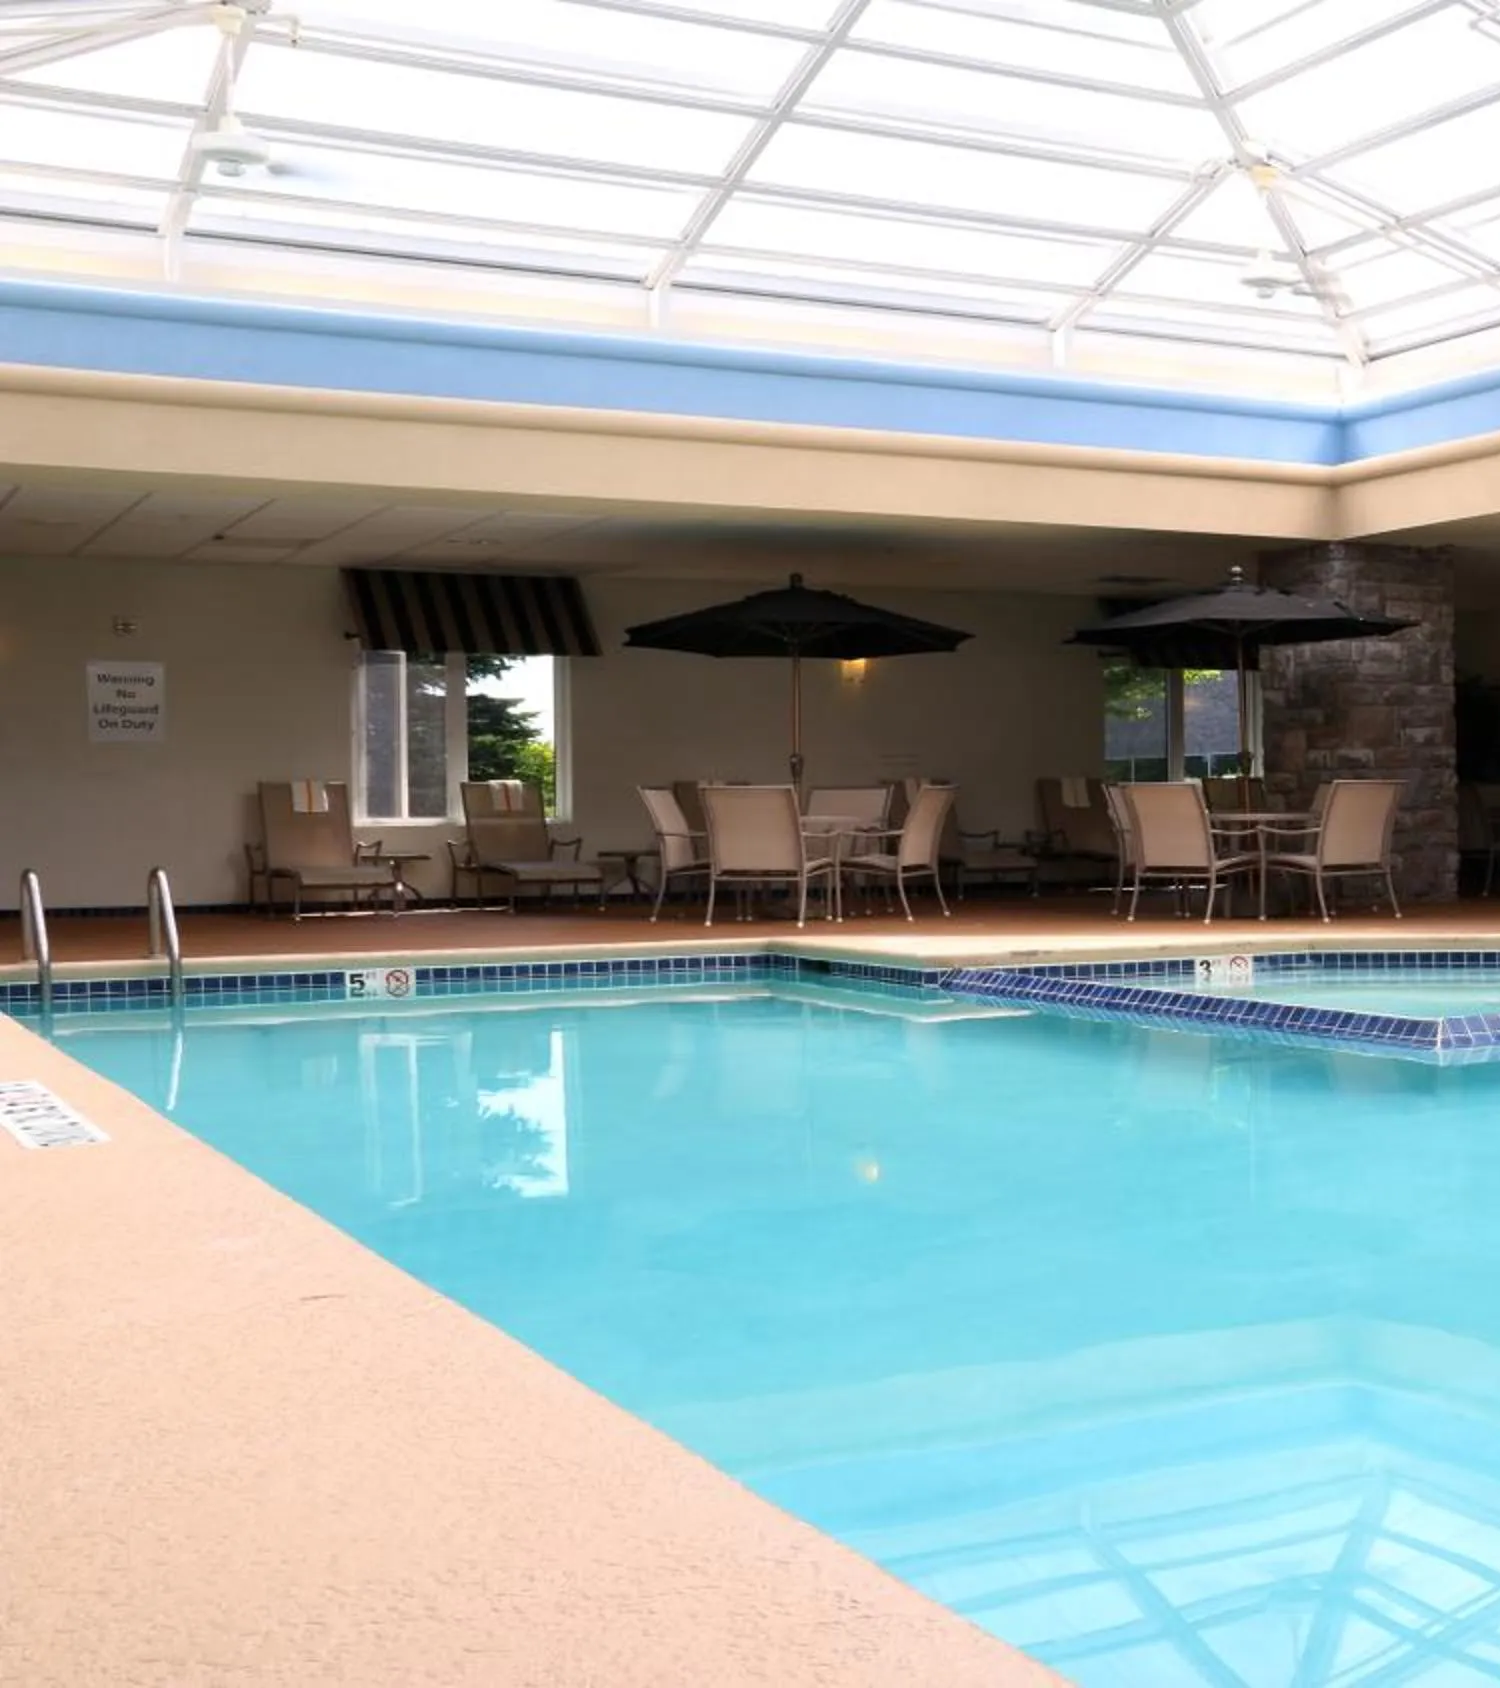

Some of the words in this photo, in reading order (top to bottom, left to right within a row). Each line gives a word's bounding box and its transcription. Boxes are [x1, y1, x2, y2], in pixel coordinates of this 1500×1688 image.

[97, 673, 155, 687] Warning
[116, 689, 136, 699] No
[93, 703, 159, 717] Lifeguard
[98, 719, 118, 729] On
[121, 719, 155, 731] Duty
[349, 973, 366, 990] 5
